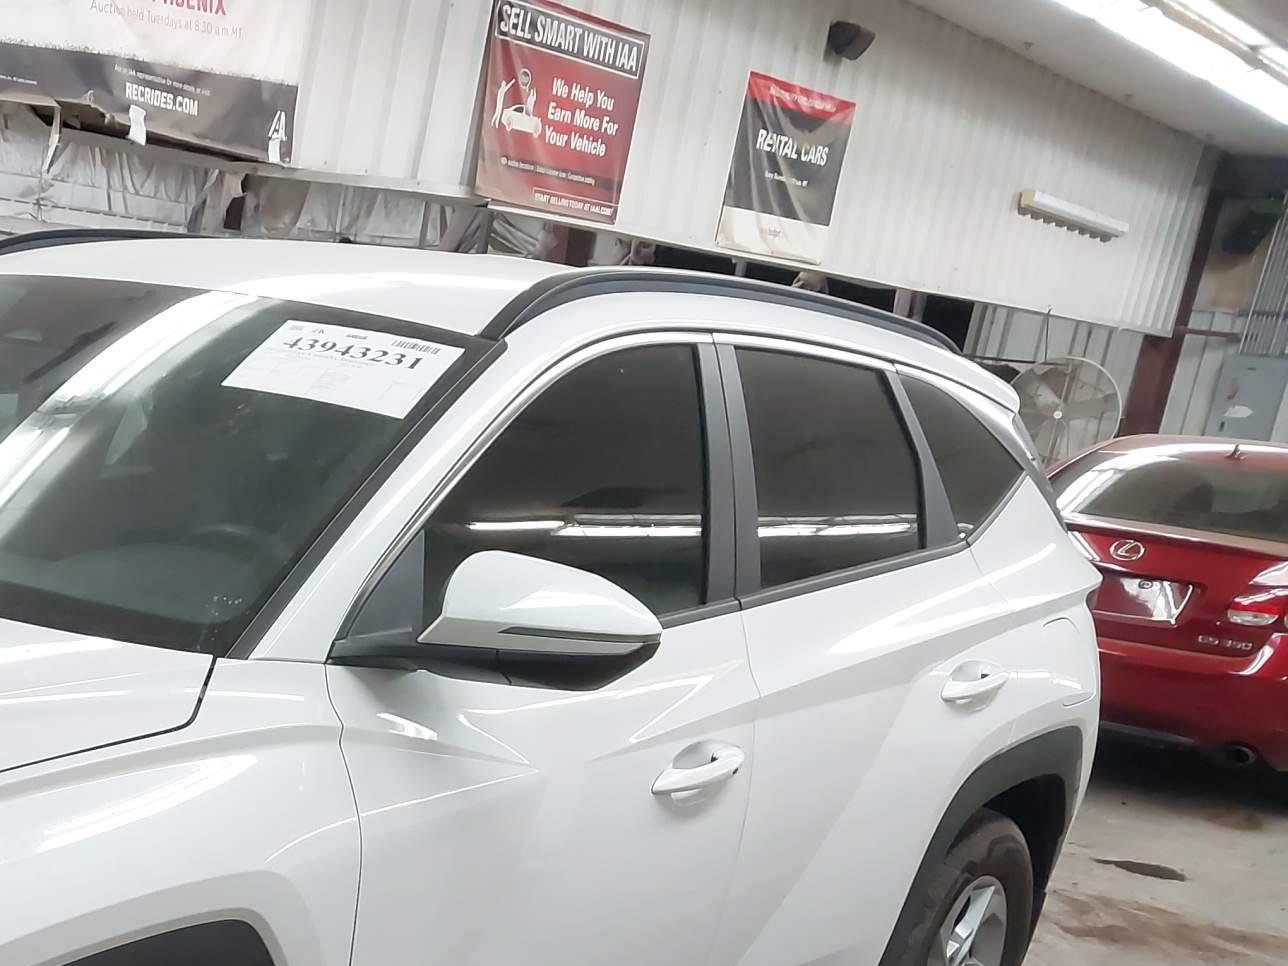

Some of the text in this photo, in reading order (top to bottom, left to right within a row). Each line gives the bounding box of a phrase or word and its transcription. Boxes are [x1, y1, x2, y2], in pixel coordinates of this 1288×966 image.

[500, 5, 638, 72] SELL SMART WITH IAA
[125, 81, 199, 117] RECRIDES.COM
[552, 77, 615, 111] We Help You
[547, 101, 619, 136] Earn More For
[544, 125, 606, 157] Your Vehicle
[756, 129, 829, 167] RENTAL CARS
[282, 336, 424, 371] 43943231
